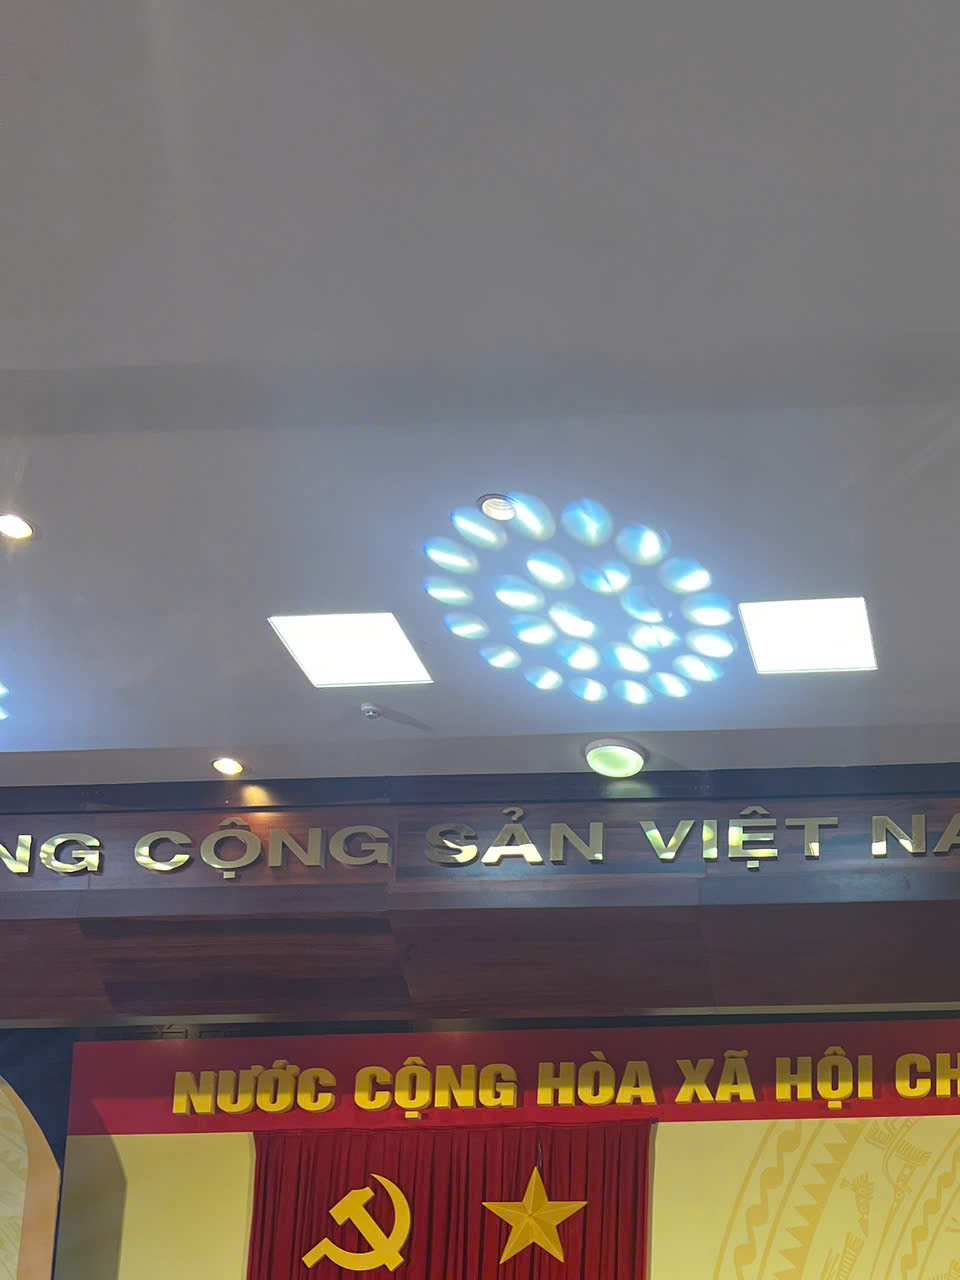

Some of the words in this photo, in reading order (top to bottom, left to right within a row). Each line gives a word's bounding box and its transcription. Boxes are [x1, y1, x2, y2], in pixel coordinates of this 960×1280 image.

[133, 818, 392, 880] CỘNG
[424, 806, 604, 867] SẢN
[639, 805, 838, 869] VIỆT
[172, 1058, 336, 1116] NƯỚC
[354, 1056, 518, 1119] CỘNG
[537, 1051, 657, 1107] HÒA
[674, 1048, 758, 1104] XÃ
[775, 1046, 874, 1110] HỘI
